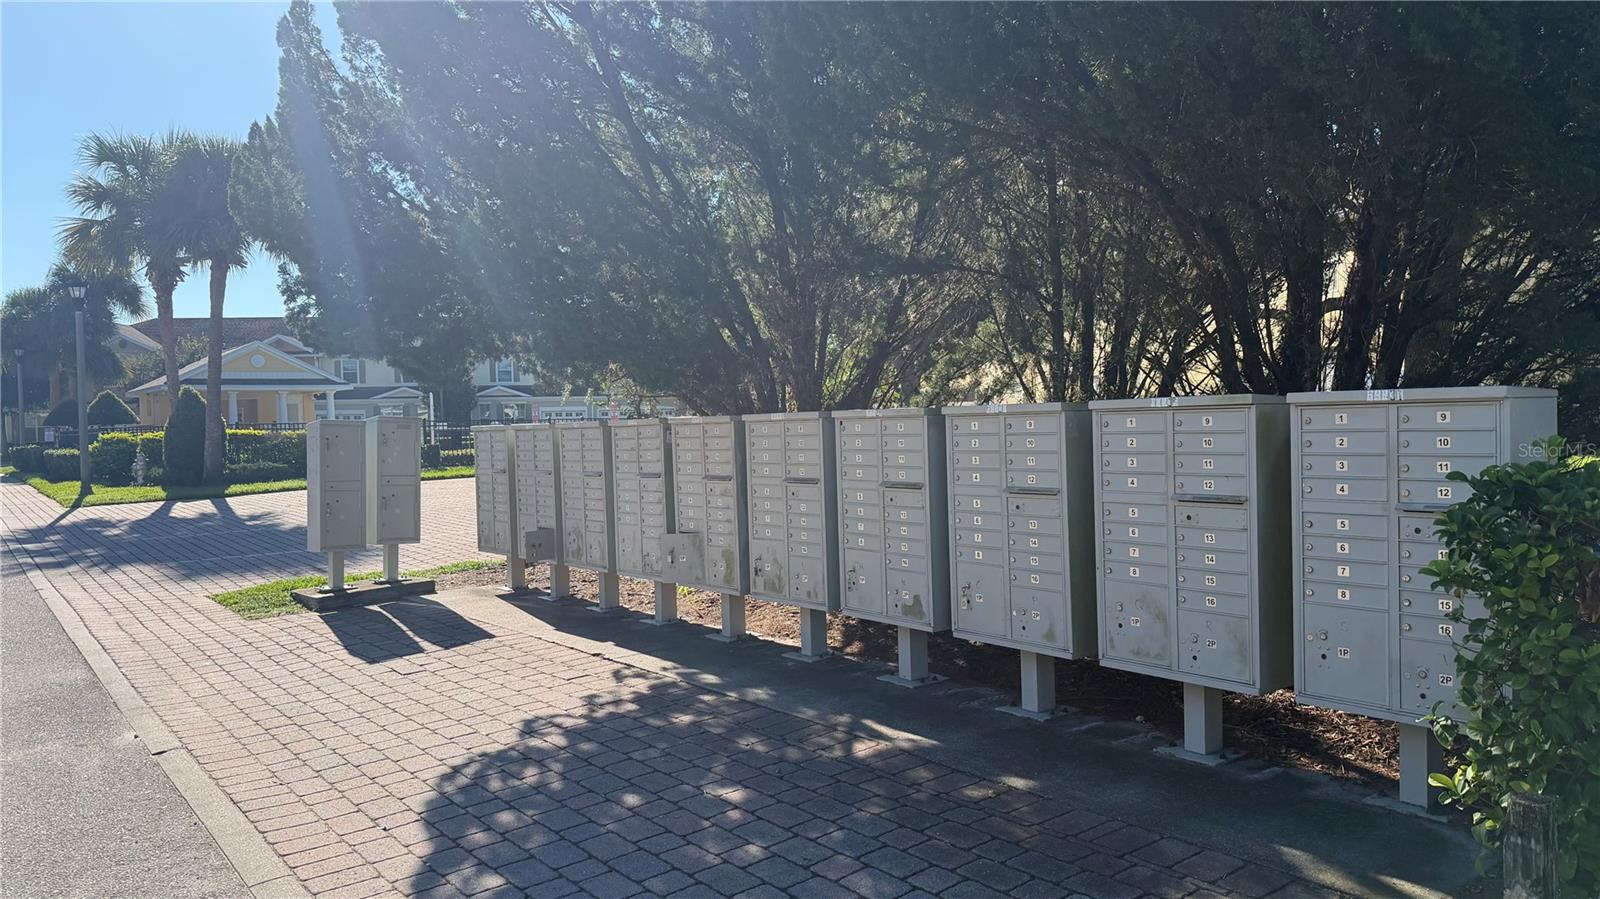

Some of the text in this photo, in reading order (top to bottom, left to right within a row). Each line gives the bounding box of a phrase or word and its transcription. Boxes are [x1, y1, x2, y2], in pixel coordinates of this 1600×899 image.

[1204, 417, 1210, 425] 9
[1339, 415, 1344, 423] 1
[1440, 412, 1447, 422] 9
[1204, 438, 1212, 447] 10
[1338, 438, 1345, 447] 2
[1438, 438, 1449, 447] 10
[1339, 461, 1345, 470] 3
[1438, 463, 1449, 471] 11
[1339, 485, 1345, 493] 4
[1438, 488, 1450, 497] 12
[1340, 520, 1346, 529] 5
[1205, 534, 1214, 542] 13
[1340, 544, 1346, 552] 6
[1340, 567, 1346, 575] 7
[1206, 577, 1215, 585] 15
[1340, 590, 1347, 599] 8
[1207, 598, 1216, 606] 16
[1440, 601, 1451, 610] 15
[1440, 626, 1451, 636] 16
[1207, 639, 1216, 647] 2P
[1339, 648, 1349, 657] 1P
[1440, 675, 1452, 685] 2P
